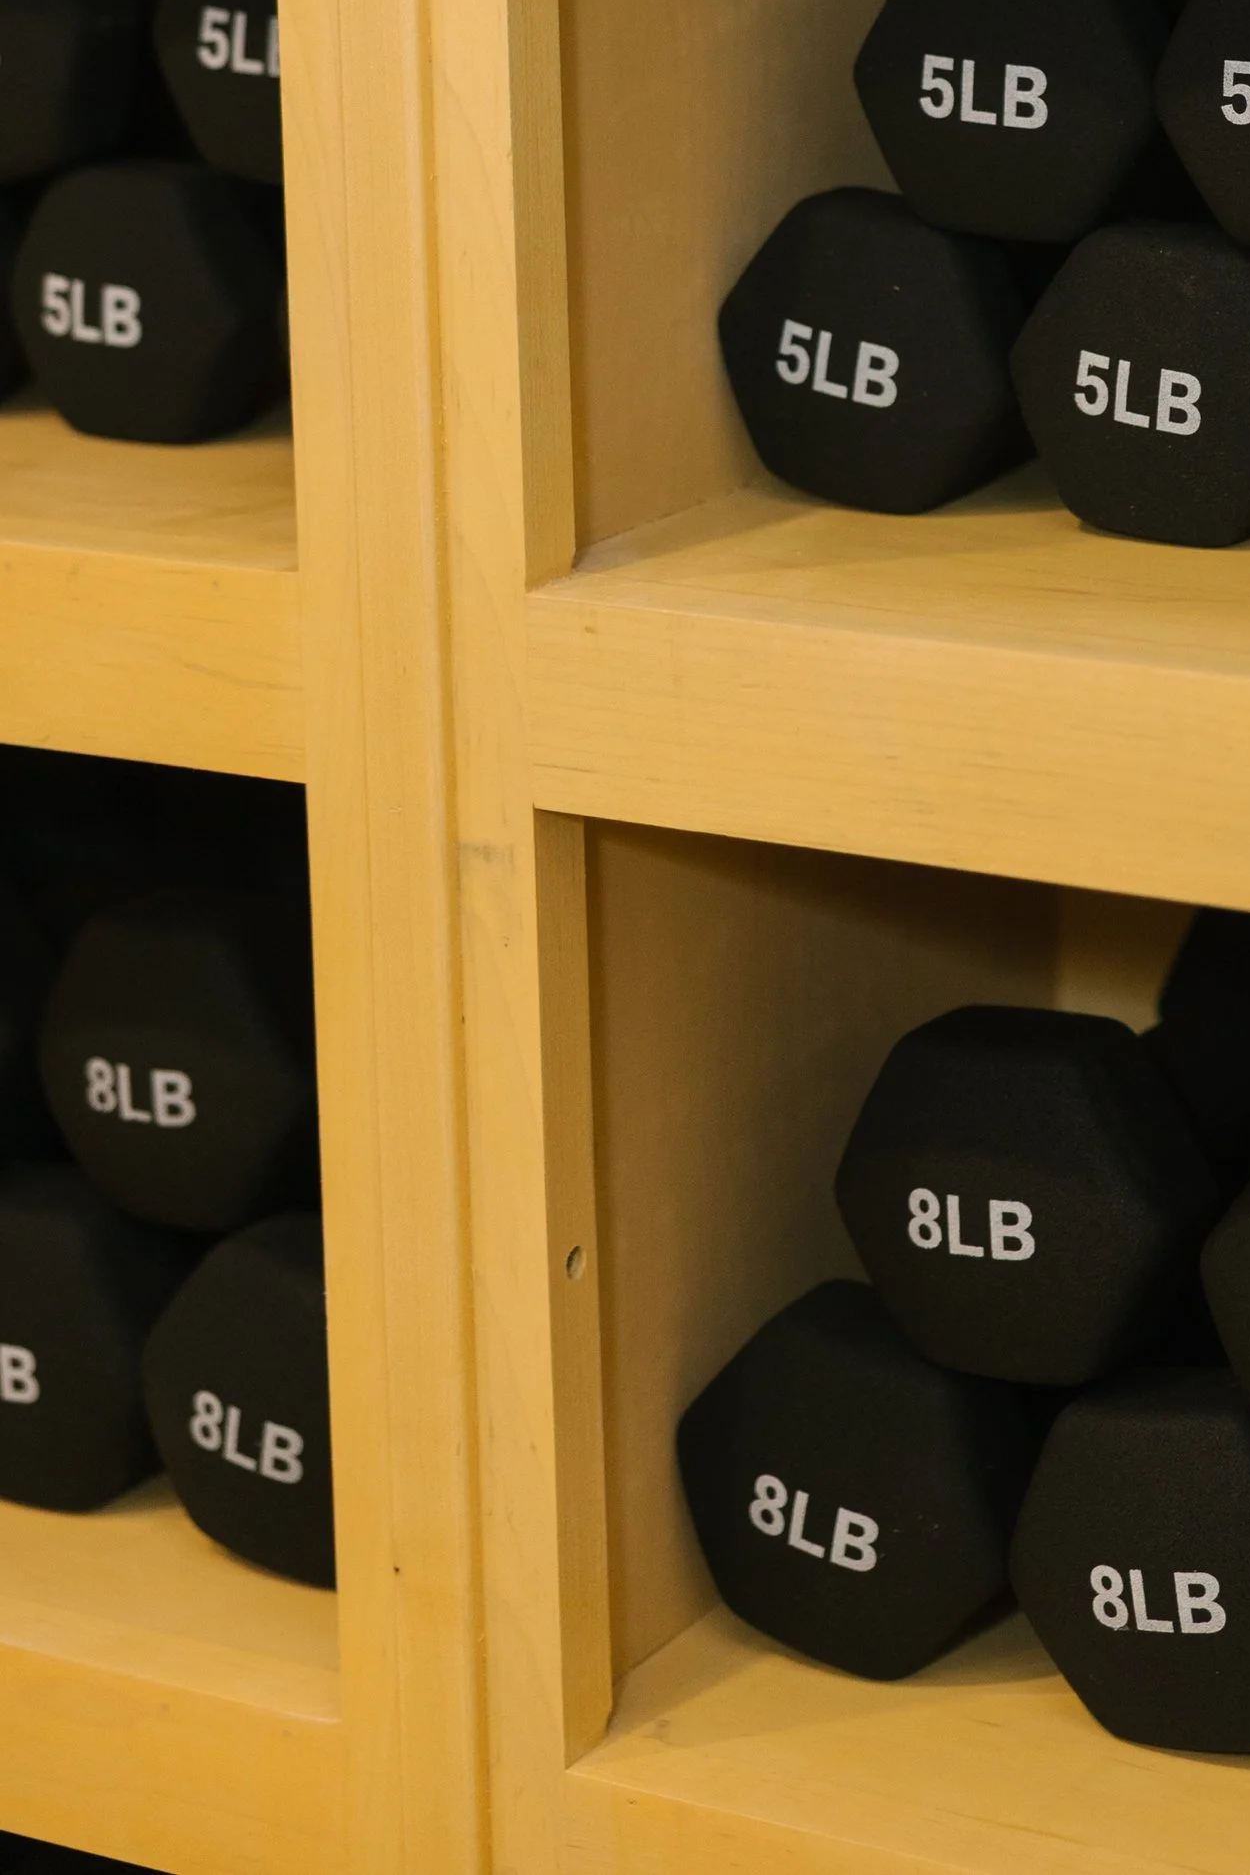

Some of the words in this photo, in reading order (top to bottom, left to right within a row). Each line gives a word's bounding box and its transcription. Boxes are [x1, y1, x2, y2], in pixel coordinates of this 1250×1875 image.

[918, 53, 1050, 131] 5LB
[42, 273, 142, 348] 5LB
[775, 318, 901, 409] 5LB
[1073, 348, 1203, 437] 5LB
[86, 1057, 196, 1127] 8LB
[907, 1186, 1037, 1262] 8LB
[190, 1390, 304, 1484] 8LB
[748, 1473, 880, 1573] 8LB
[1089, 1563, 1228, 1635] 8LB
